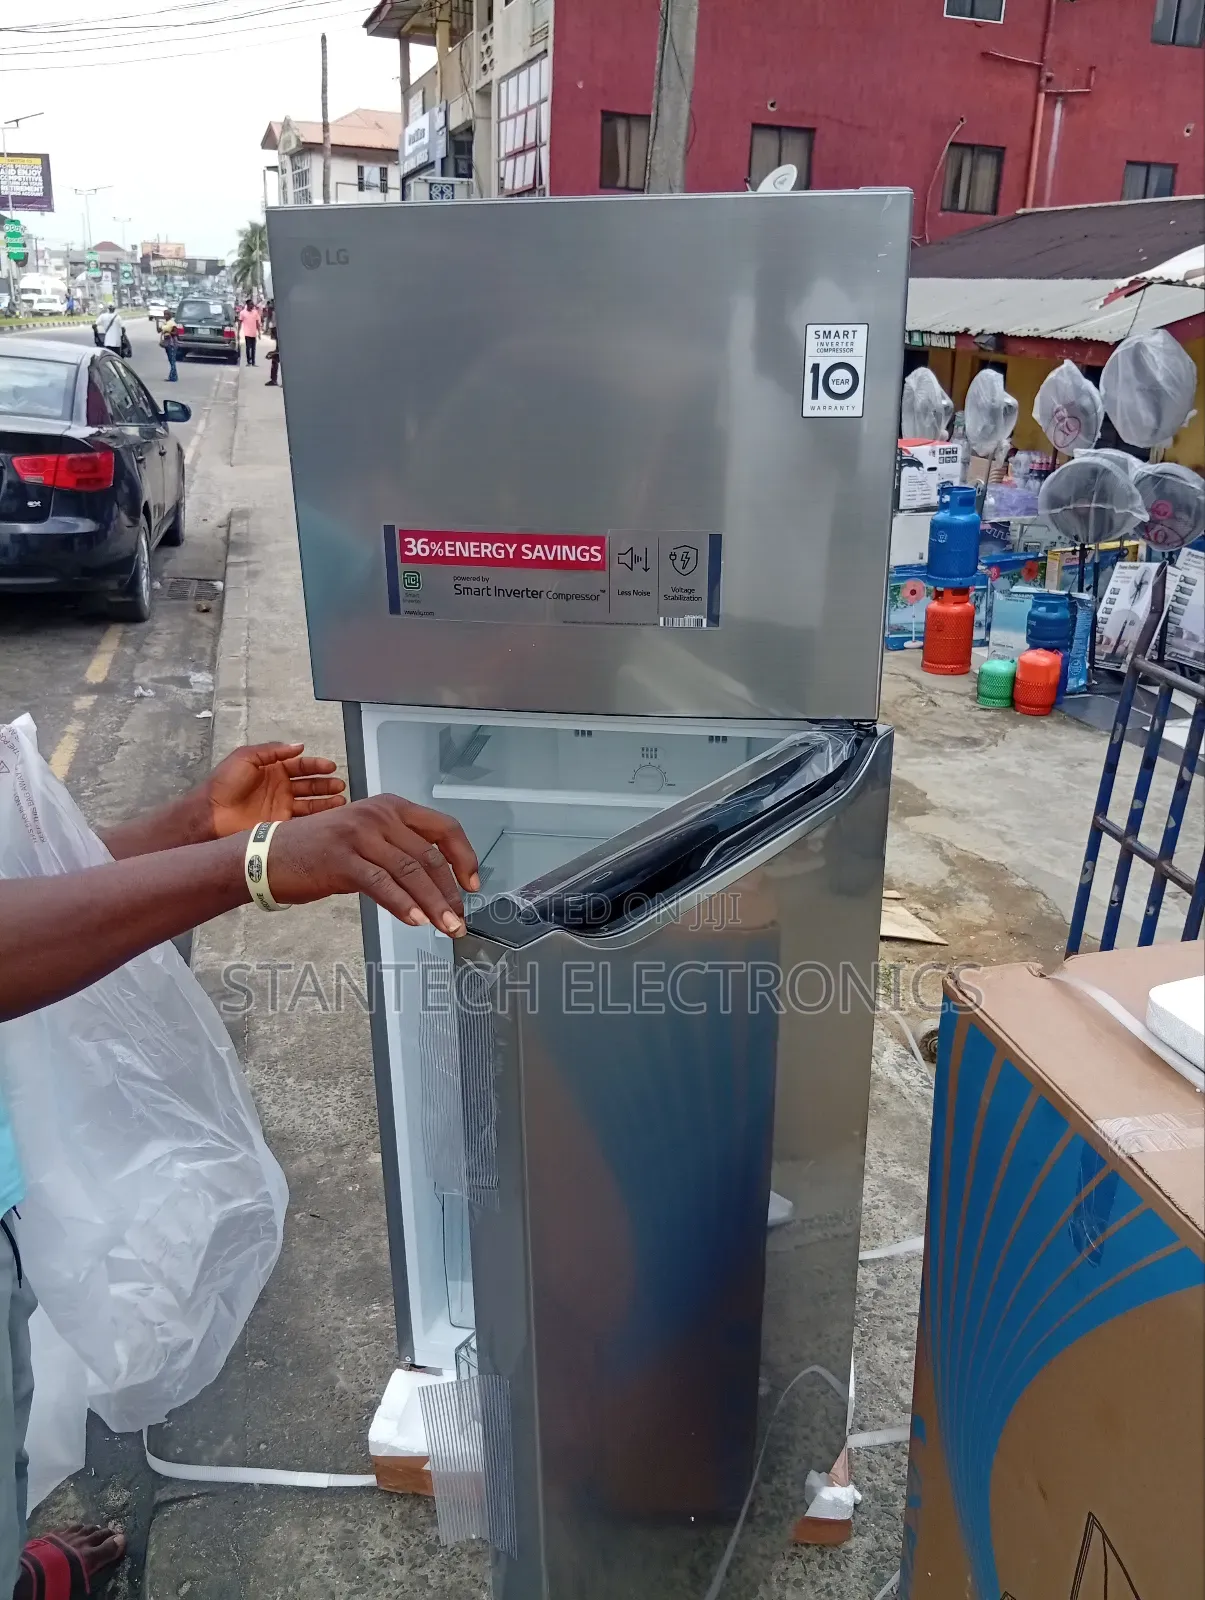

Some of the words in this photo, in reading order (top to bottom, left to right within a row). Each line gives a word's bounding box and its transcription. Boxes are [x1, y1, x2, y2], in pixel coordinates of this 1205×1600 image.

[326, 248, 349, 265] LG
[814, 330, 858, 340] SMART
[810, 361, 860, 401] 10
[831, 378, 850, 386] YEAR
[521, 543, 602, 562] SAVINGS
[481, 575, 490, 583] by
[454, 584, 491, 597] Smart
[494, 585, 545, 599] Inverter
[633, 589, 651, 597] Noise
[671, 586, 696, 594] Voltage
[663, 594, 703, 602] Stabilization
[24, 791, 35, 807] BAG
